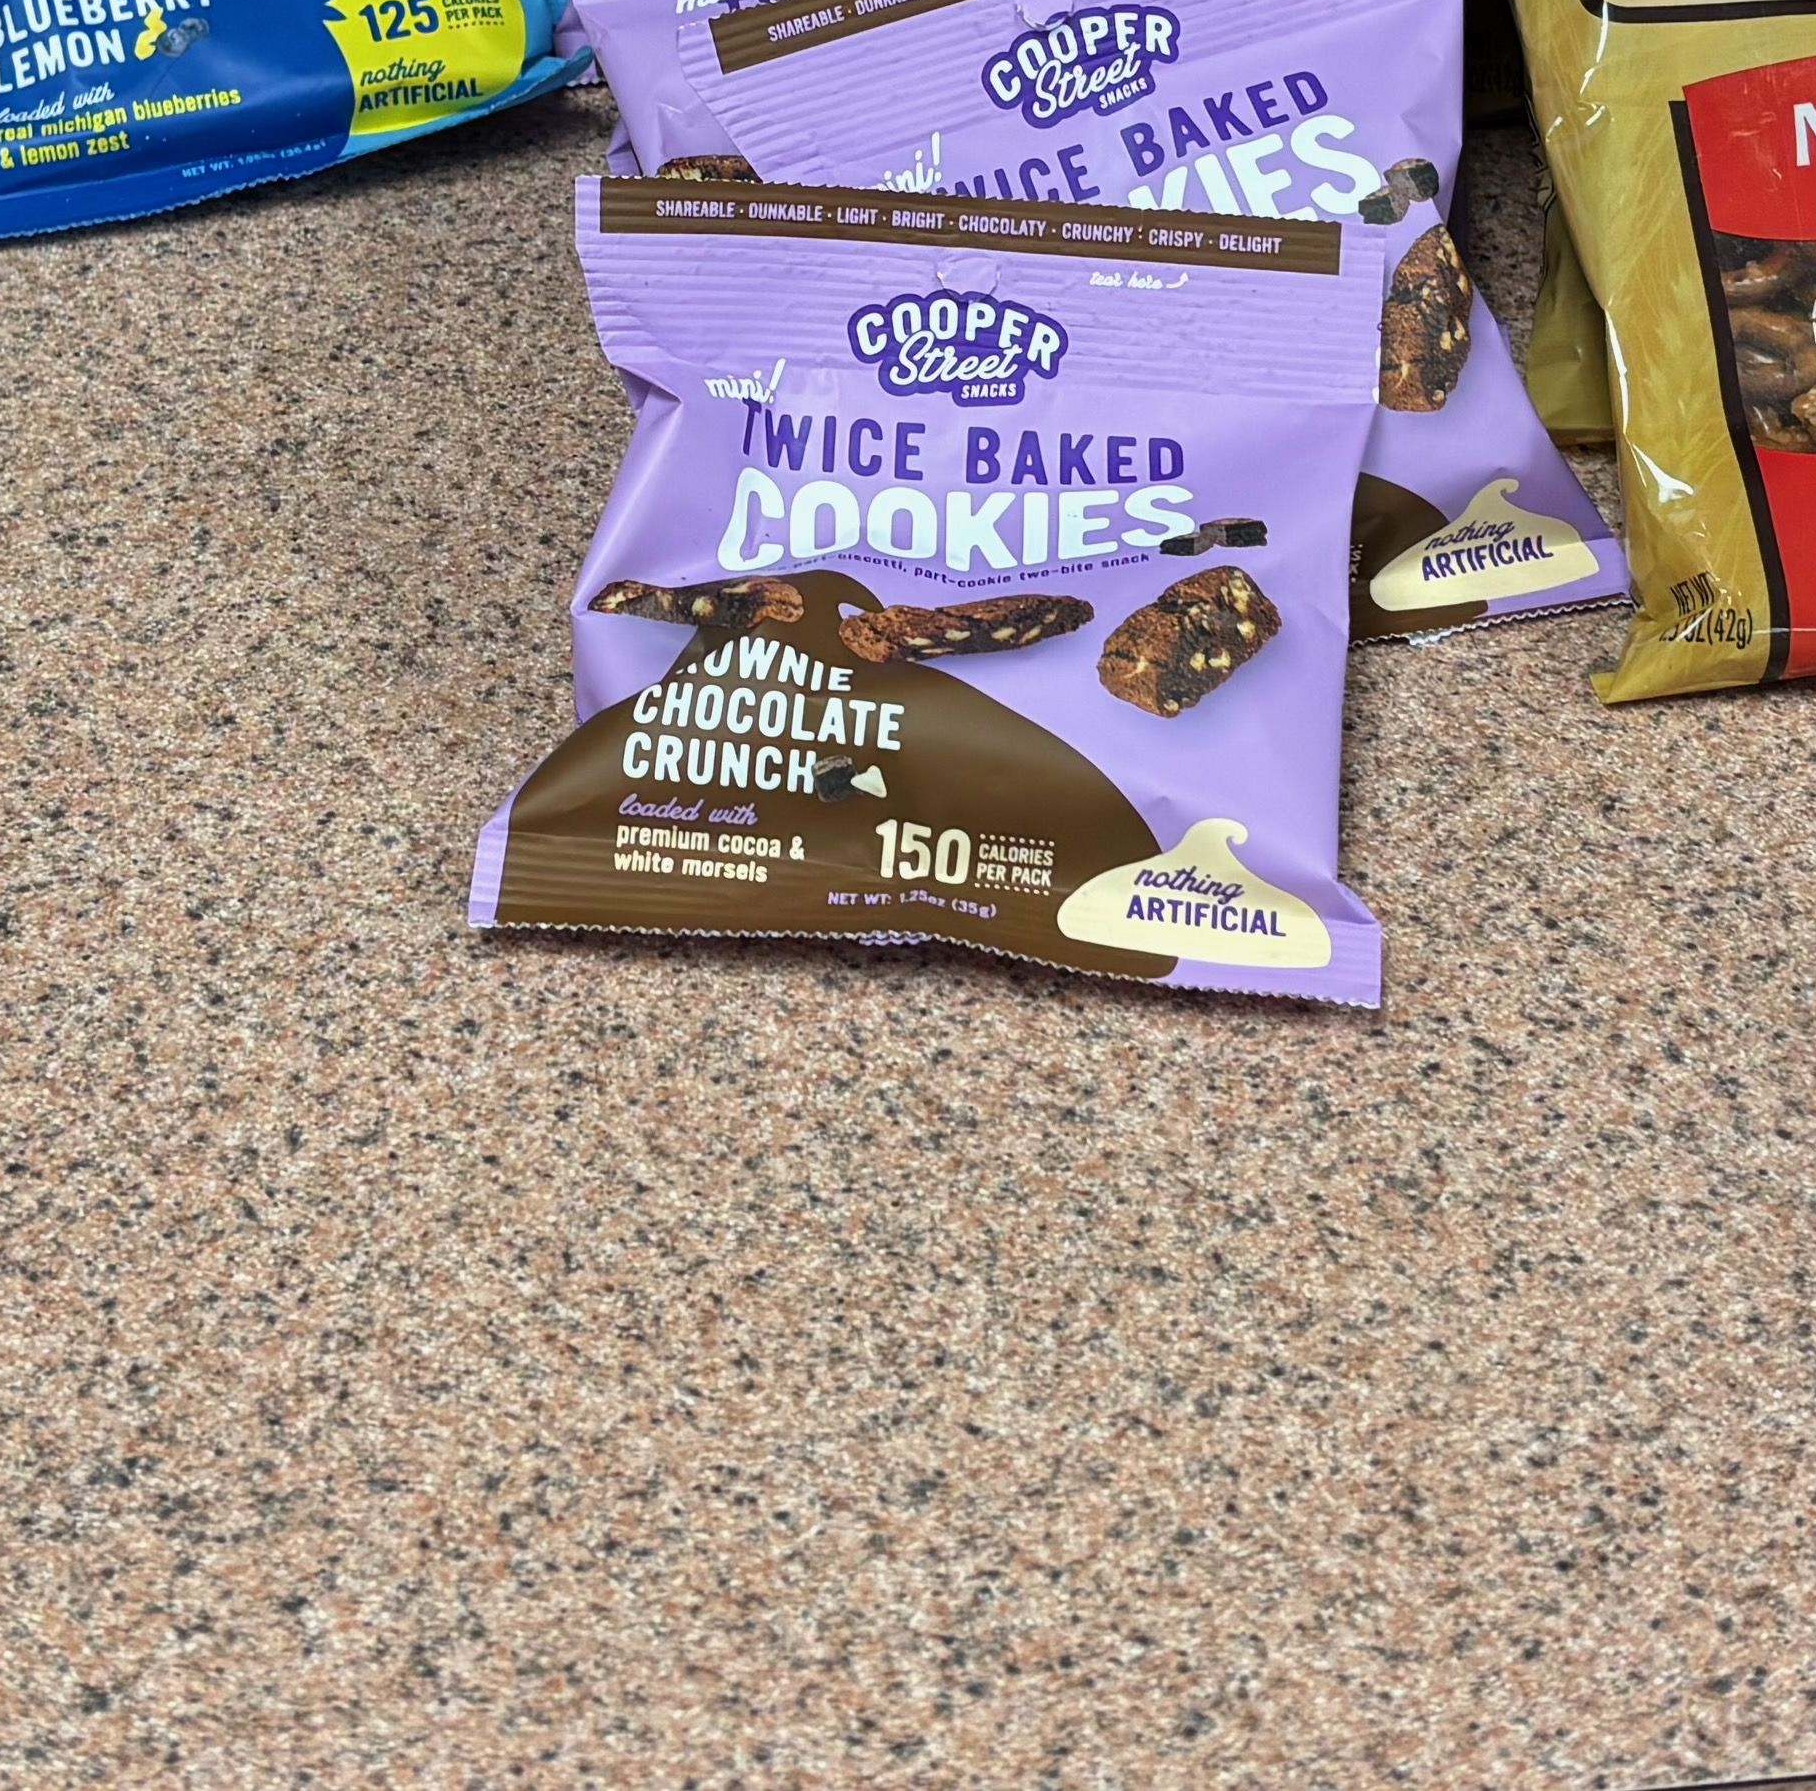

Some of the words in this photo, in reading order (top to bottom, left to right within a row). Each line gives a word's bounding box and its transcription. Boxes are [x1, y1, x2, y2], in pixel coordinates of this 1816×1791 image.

[360, 57, 447, 88] nothing
[988, 8, 1177, 93] COOPER
[73, 83, 115, 114] with
[358, 78, 484, 111] ARTIFICIAL
[1034, 48, 1143, 122] Street
[40, 107, 128, 141] michigan
[133, 87, 242, 123] blueberries
[1120, 71, 1330, 178] BAKED
[856, 298, 1061, 371] COOPER
[891, 331, 1019, 386] Street
[704, 356, 786, 403] mini!
[961, 382, 1017, 399] SNACKS
[741, 399, 928, 483] TWICE
[964, 427, 1184, 484] BAKED
[715, 467, 1195, 572] COOKIES
[1423, 517, 1514, 554] nothing
[1421, 532, 1554, 582] ARTIFICIAL
[632, 682, 905, 751] CHOCOLATE
[622, 731, 818, 795] CRUNCH
[618, 794, 699, 823] loaded
[707, 802, 758, 826] with
[613, 849, 675, 875] white
[682, 857, 769, 883] morsels
[876, 818, 972, 885] 150
[978, 843, 1054, 867] CALORIES
[1134, 864, 1246, 906] nothing
[1125, 896, 1286, 938] ARTIFICIAL
